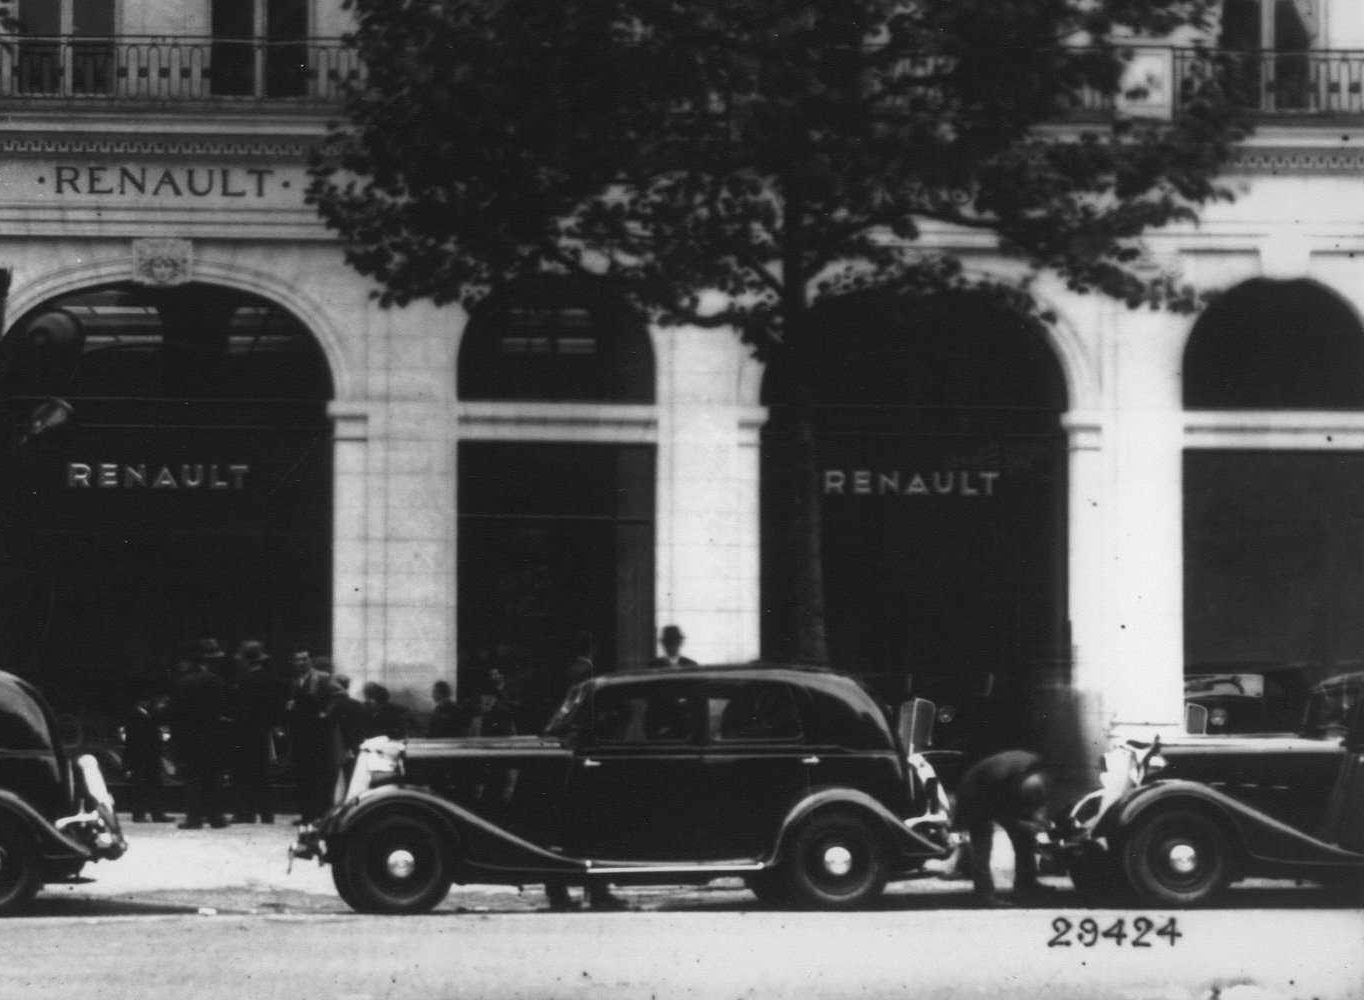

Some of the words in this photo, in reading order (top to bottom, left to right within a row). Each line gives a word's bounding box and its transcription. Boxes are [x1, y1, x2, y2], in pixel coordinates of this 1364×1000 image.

[53, 166, 275, 198] RENAULT
[67, 462, 250, 489] RENAULT
[823, 470, 1000, 496] RENAULT
